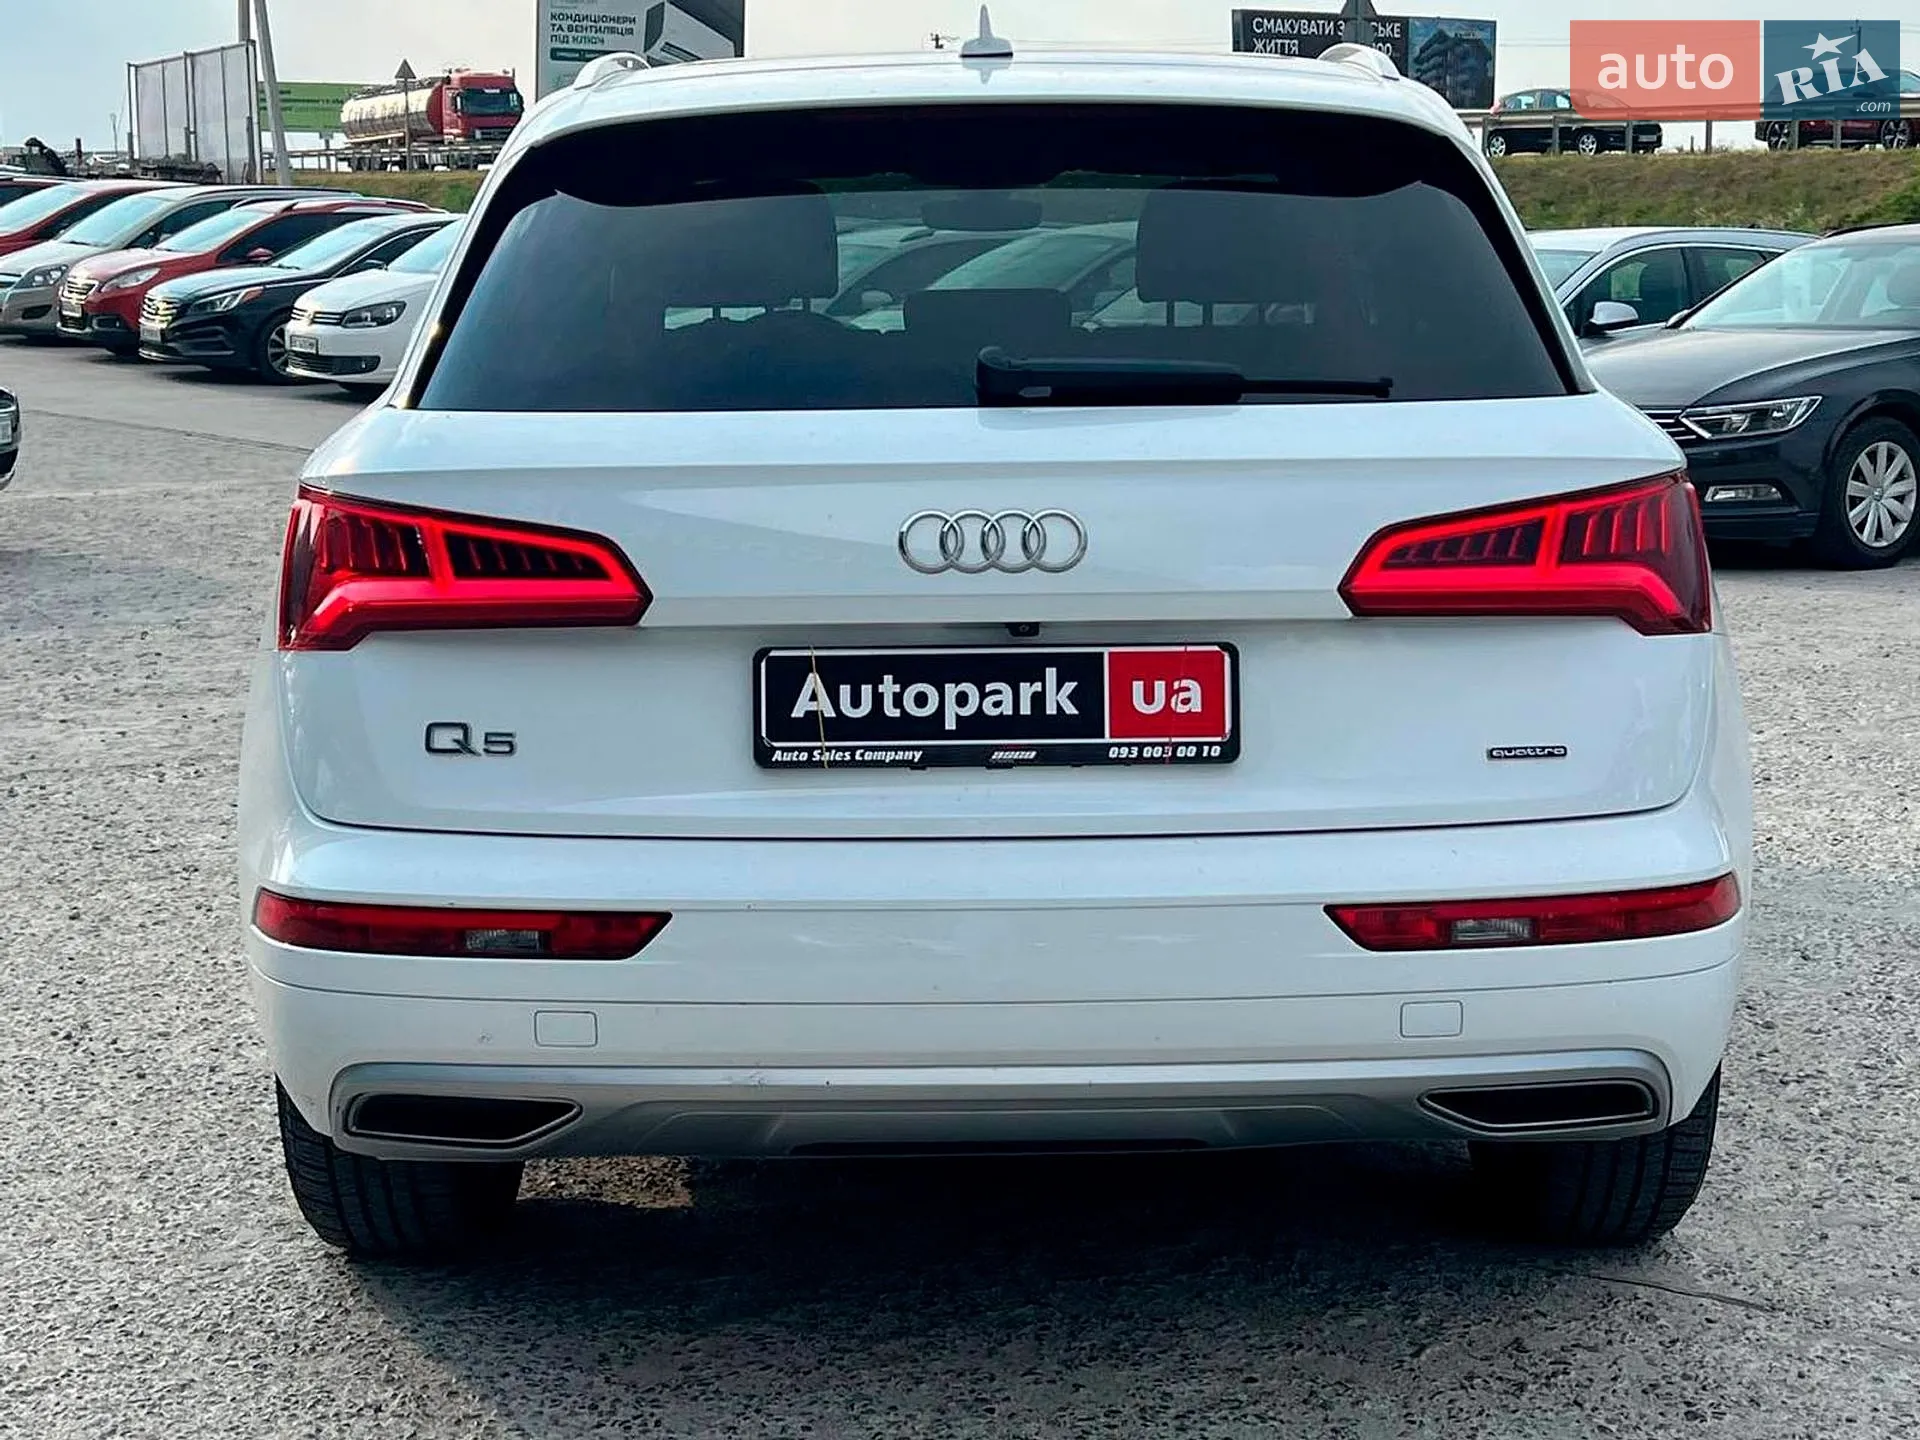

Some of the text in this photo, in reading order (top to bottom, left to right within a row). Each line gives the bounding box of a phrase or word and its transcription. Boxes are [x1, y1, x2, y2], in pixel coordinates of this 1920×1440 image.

[550, 12, 636, 25] КОНДИЦІОНЕРИ
[550, 23, 634, 36] ТА ВЕНТИЛЯЦІЯ
[1252, 17, 1334, 36] СМАКУВАТИ
[550, 35, 605, 45] ПІД КЛЮЧ
[1253, 38, 1299, 55] ЖИТТЯ
[790, 666, 1203, 731] Autopark ua
[424, 721, 517, 757] Q5
[771, 749, 924, 763] Auto Sales Company
[1108, 746, 1139, 758] 093
[1176, 745, 1197, 757] 00
[1202, 745, 1222, 757] 10
[1491, 746, 1566, 759] quattro
